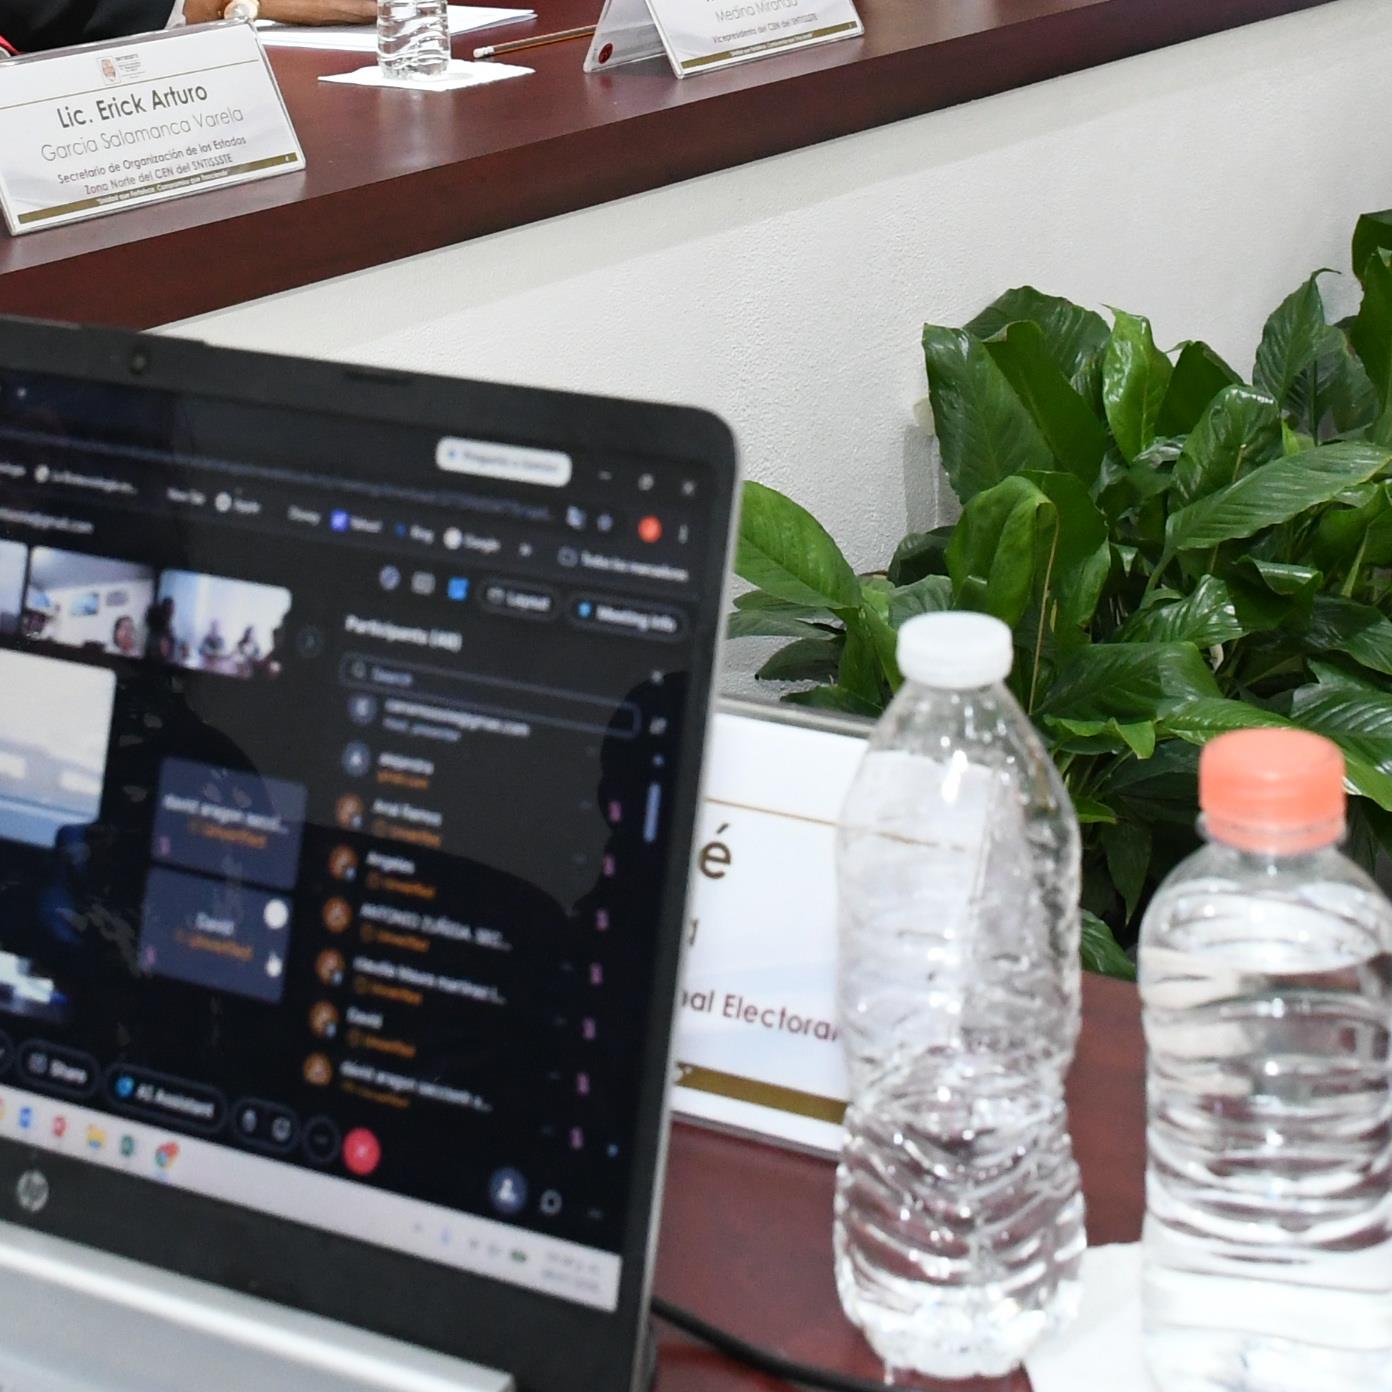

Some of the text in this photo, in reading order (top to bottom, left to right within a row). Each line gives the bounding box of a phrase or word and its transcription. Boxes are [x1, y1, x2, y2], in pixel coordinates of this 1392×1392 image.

[57, 85, 208, 129] Lic. Erick Arturo
[100, 119, 191, 150] Salamanca
[192, 106, 244, 130] Varela
[57, 164, 106, 185] Secretario
[108, 160, 121, 173] de
[122, 149, 184, 171] Organización
[185, 143, 198, 156] de
[213, 135, 247, 151] Estados
[84, 183, 109, 195] Zona
[110, 176, 136, 190] Norte
[139, 172, 153, 183] del
[154, 167, 174, 179] CEN
[176, 163, 190, 174] del
